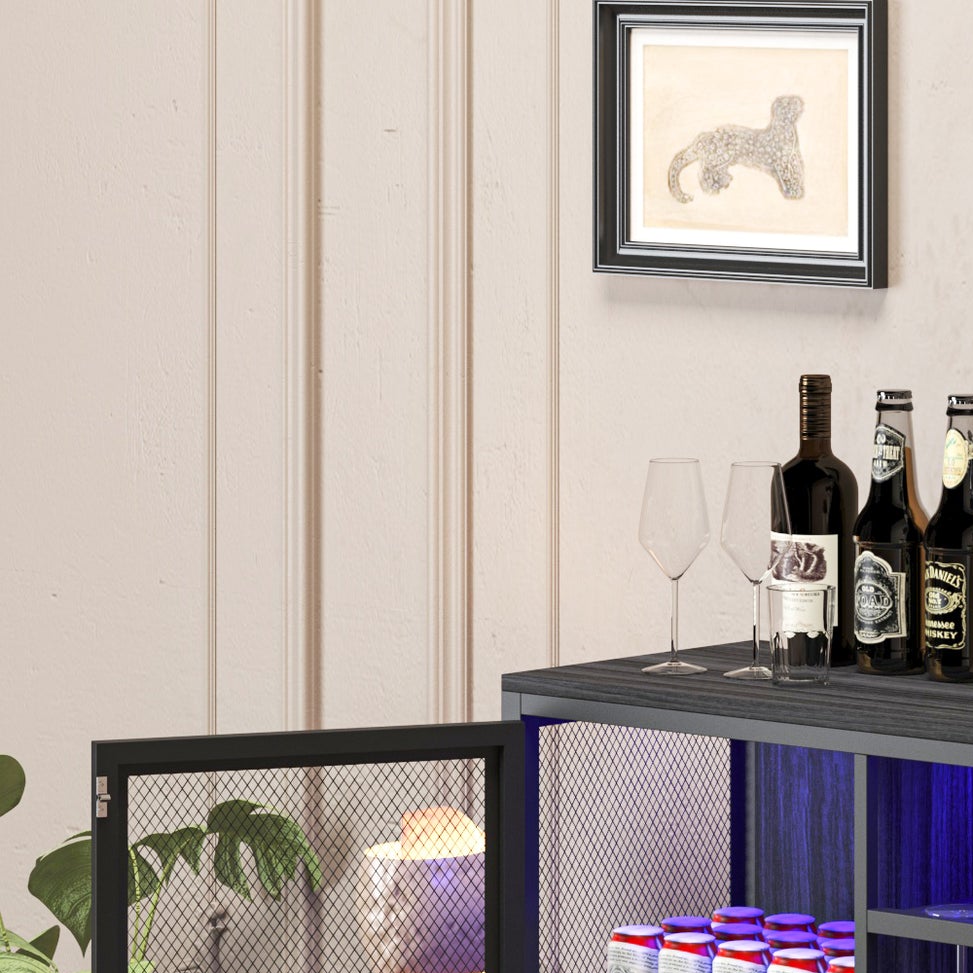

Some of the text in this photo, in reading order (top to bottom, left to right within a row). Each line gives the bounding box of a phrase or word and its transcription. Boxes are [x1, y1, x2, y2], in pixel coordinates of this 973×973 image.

[929, 565, 960, 589] DANIEL'S
[861, 585, 875, 593] OLD
[857, 594, 889, 608] OAD
